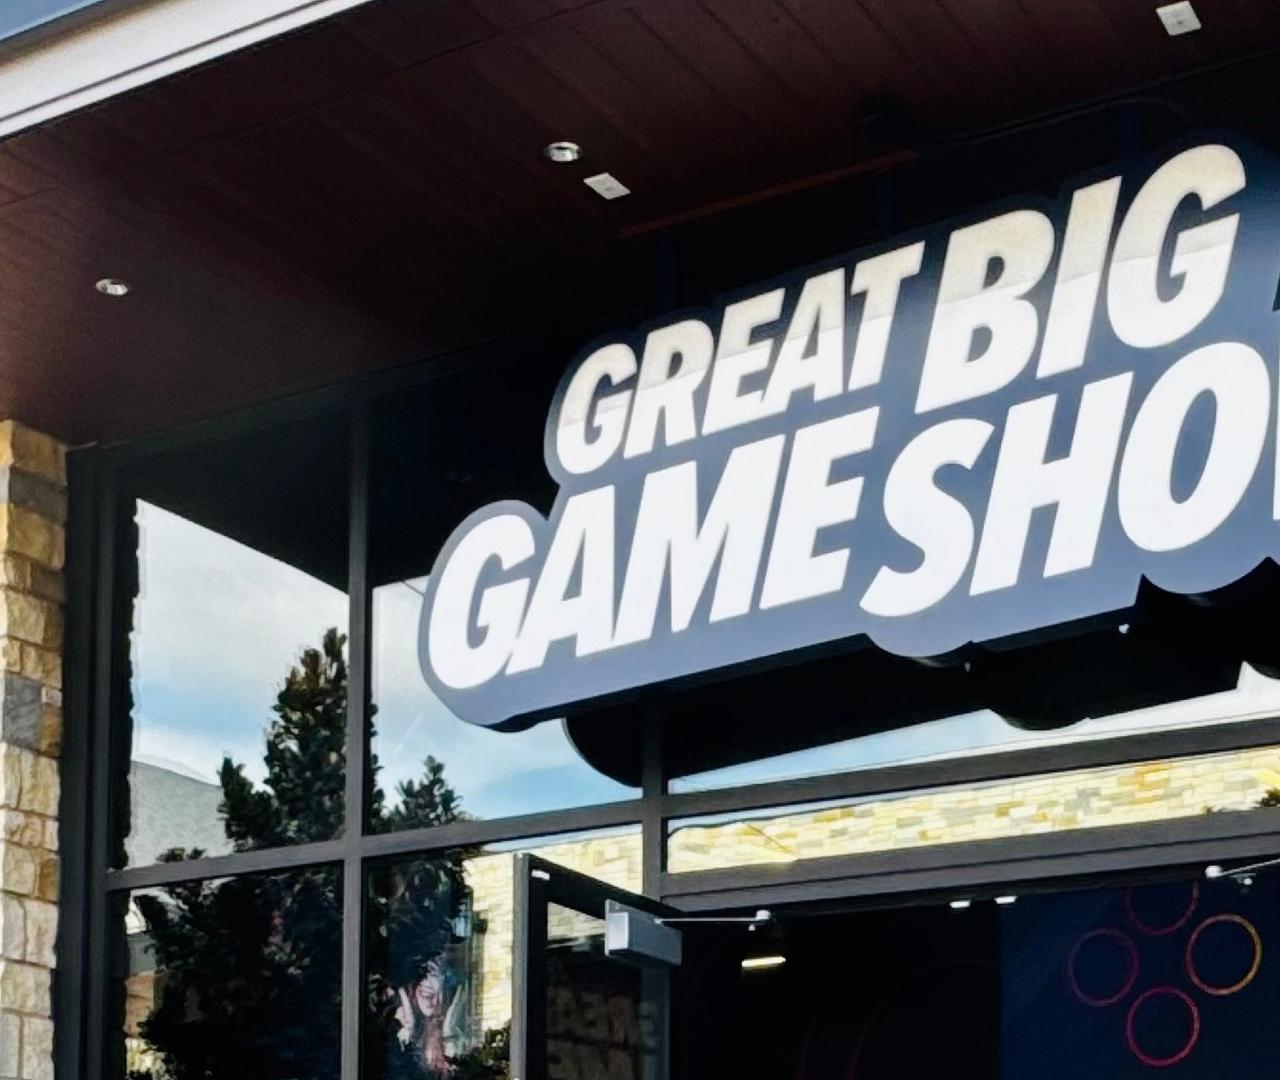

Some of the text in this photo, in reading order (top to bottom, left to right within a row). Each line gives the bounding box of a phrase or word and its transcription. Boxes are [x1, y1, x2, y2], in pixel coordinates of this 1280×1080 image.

[555, 144, 1246, 475] GREAT BIG
[426, 406, 880, 689] GAME
